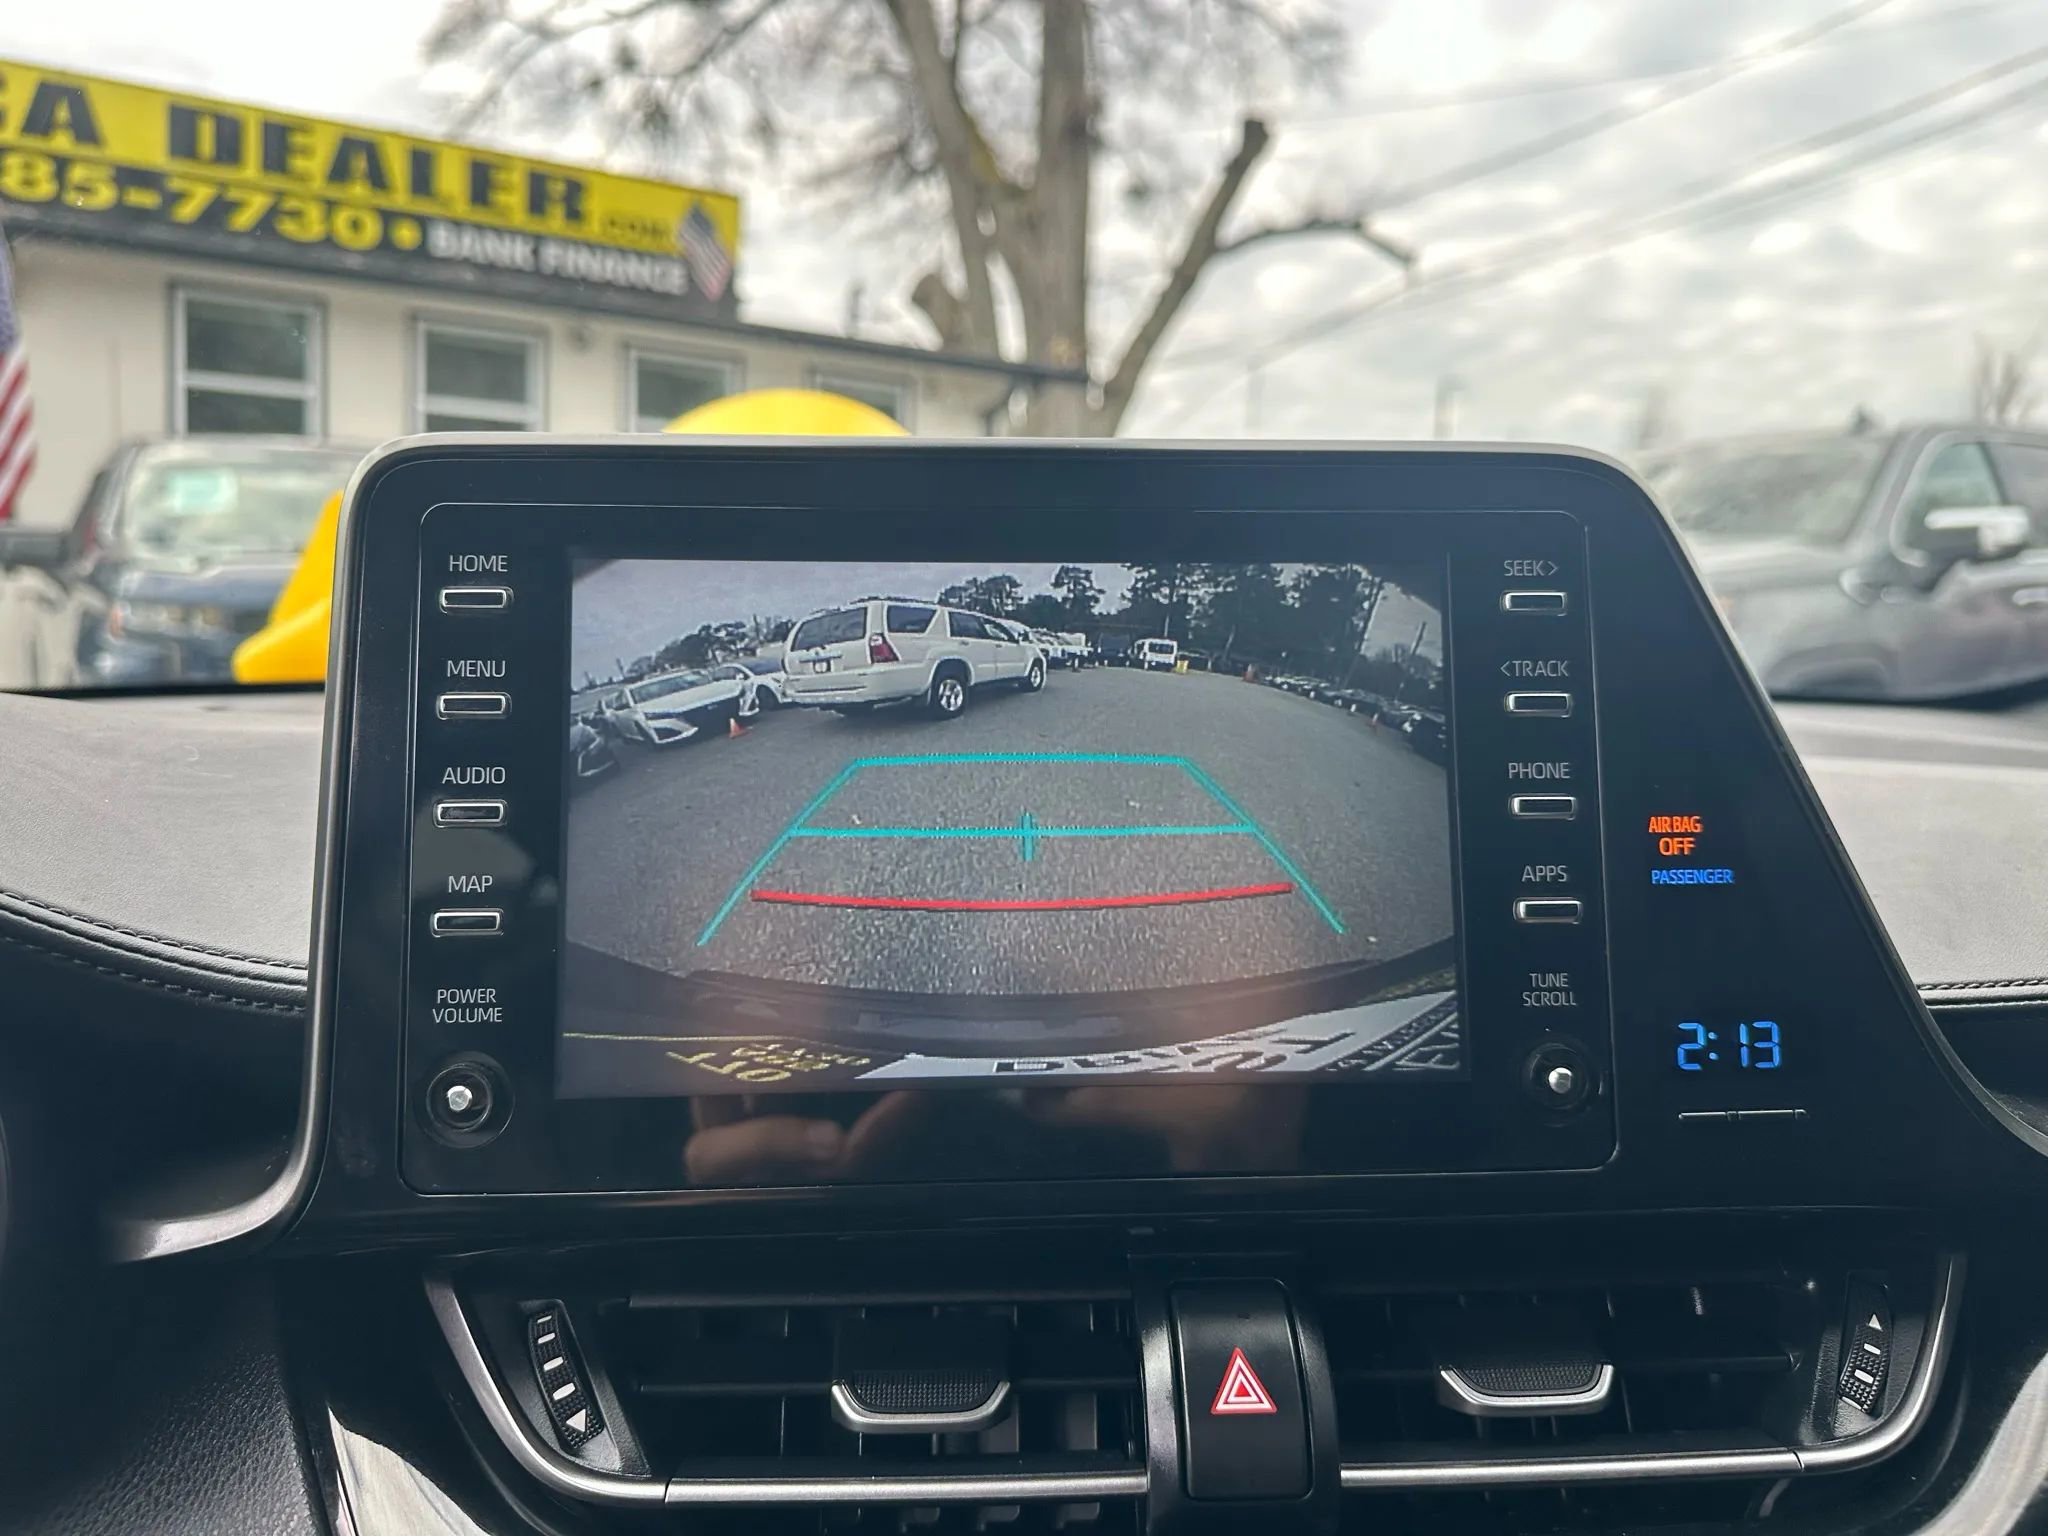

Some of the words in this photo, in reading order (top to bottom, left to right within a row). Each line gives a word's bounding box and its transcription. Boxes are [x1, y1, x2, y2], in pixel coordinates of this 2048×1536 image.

[166, 102, 588, 224] DEALER
[427, 218, 537, 272] BANK
[538, 238, 690, 296] FINANCE
[449, 554, 508, 573] HOME
[446, 659, 507, 678] MENU
[441, 766, 507, 785] AUDIO
[1507, 762, 1571, 779] PHONE
[1659, 837, 1696, 856] OFF
[1521, 865, 1568, 882] APPS
[1650, 868, 1735, 885] PASSENGER
[447, 874, 494, 893] MAP
[1528, 972, 1569, 988] TUNE
[436, 988, 497, 1004] POWER
[1521, 991, 1577, 1007] SCROLL
[432, 1006, 503, 1024] VOLUME
[1676, 1020, 1782, 1071] 2:13
